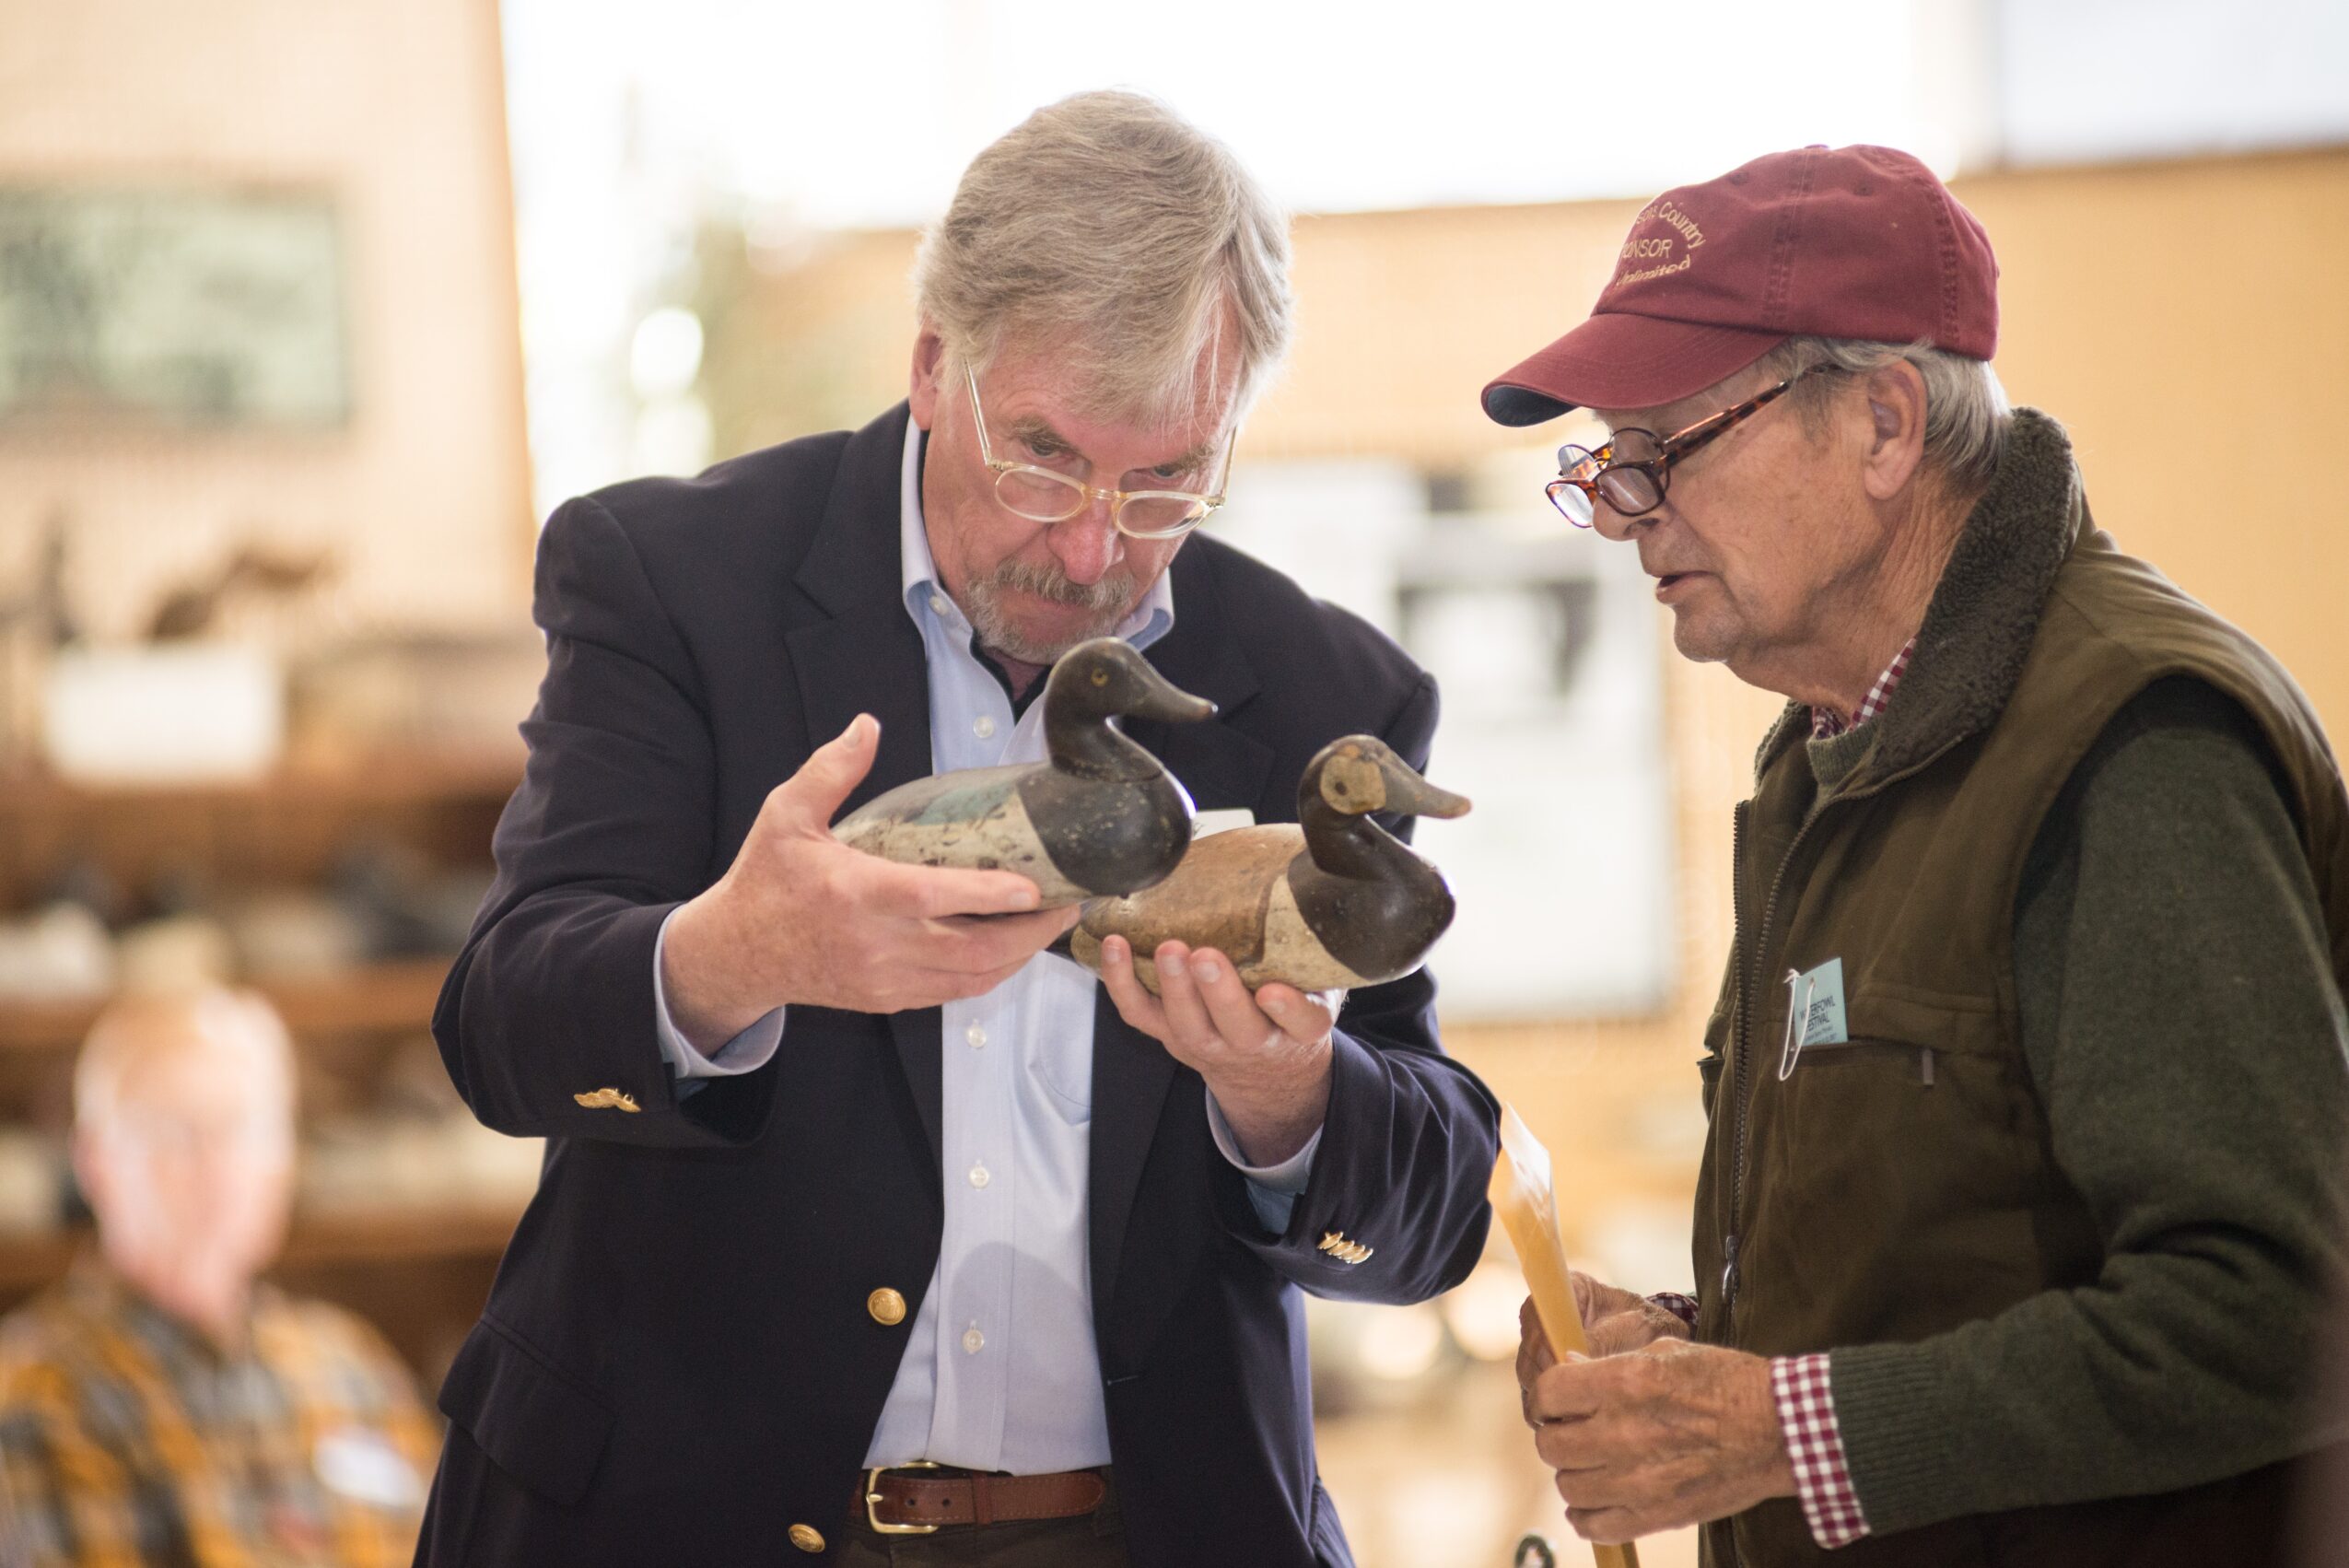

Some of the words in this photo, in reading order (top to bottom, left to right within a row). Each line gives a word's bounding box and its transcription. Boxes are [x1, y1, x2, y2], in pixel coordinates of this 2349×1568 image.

[1659, 201, 1706, 250] Country
[1622, 239, 1673, 259] ONSOR
[1800, 995, 1836, 1022] WTERFOWL
